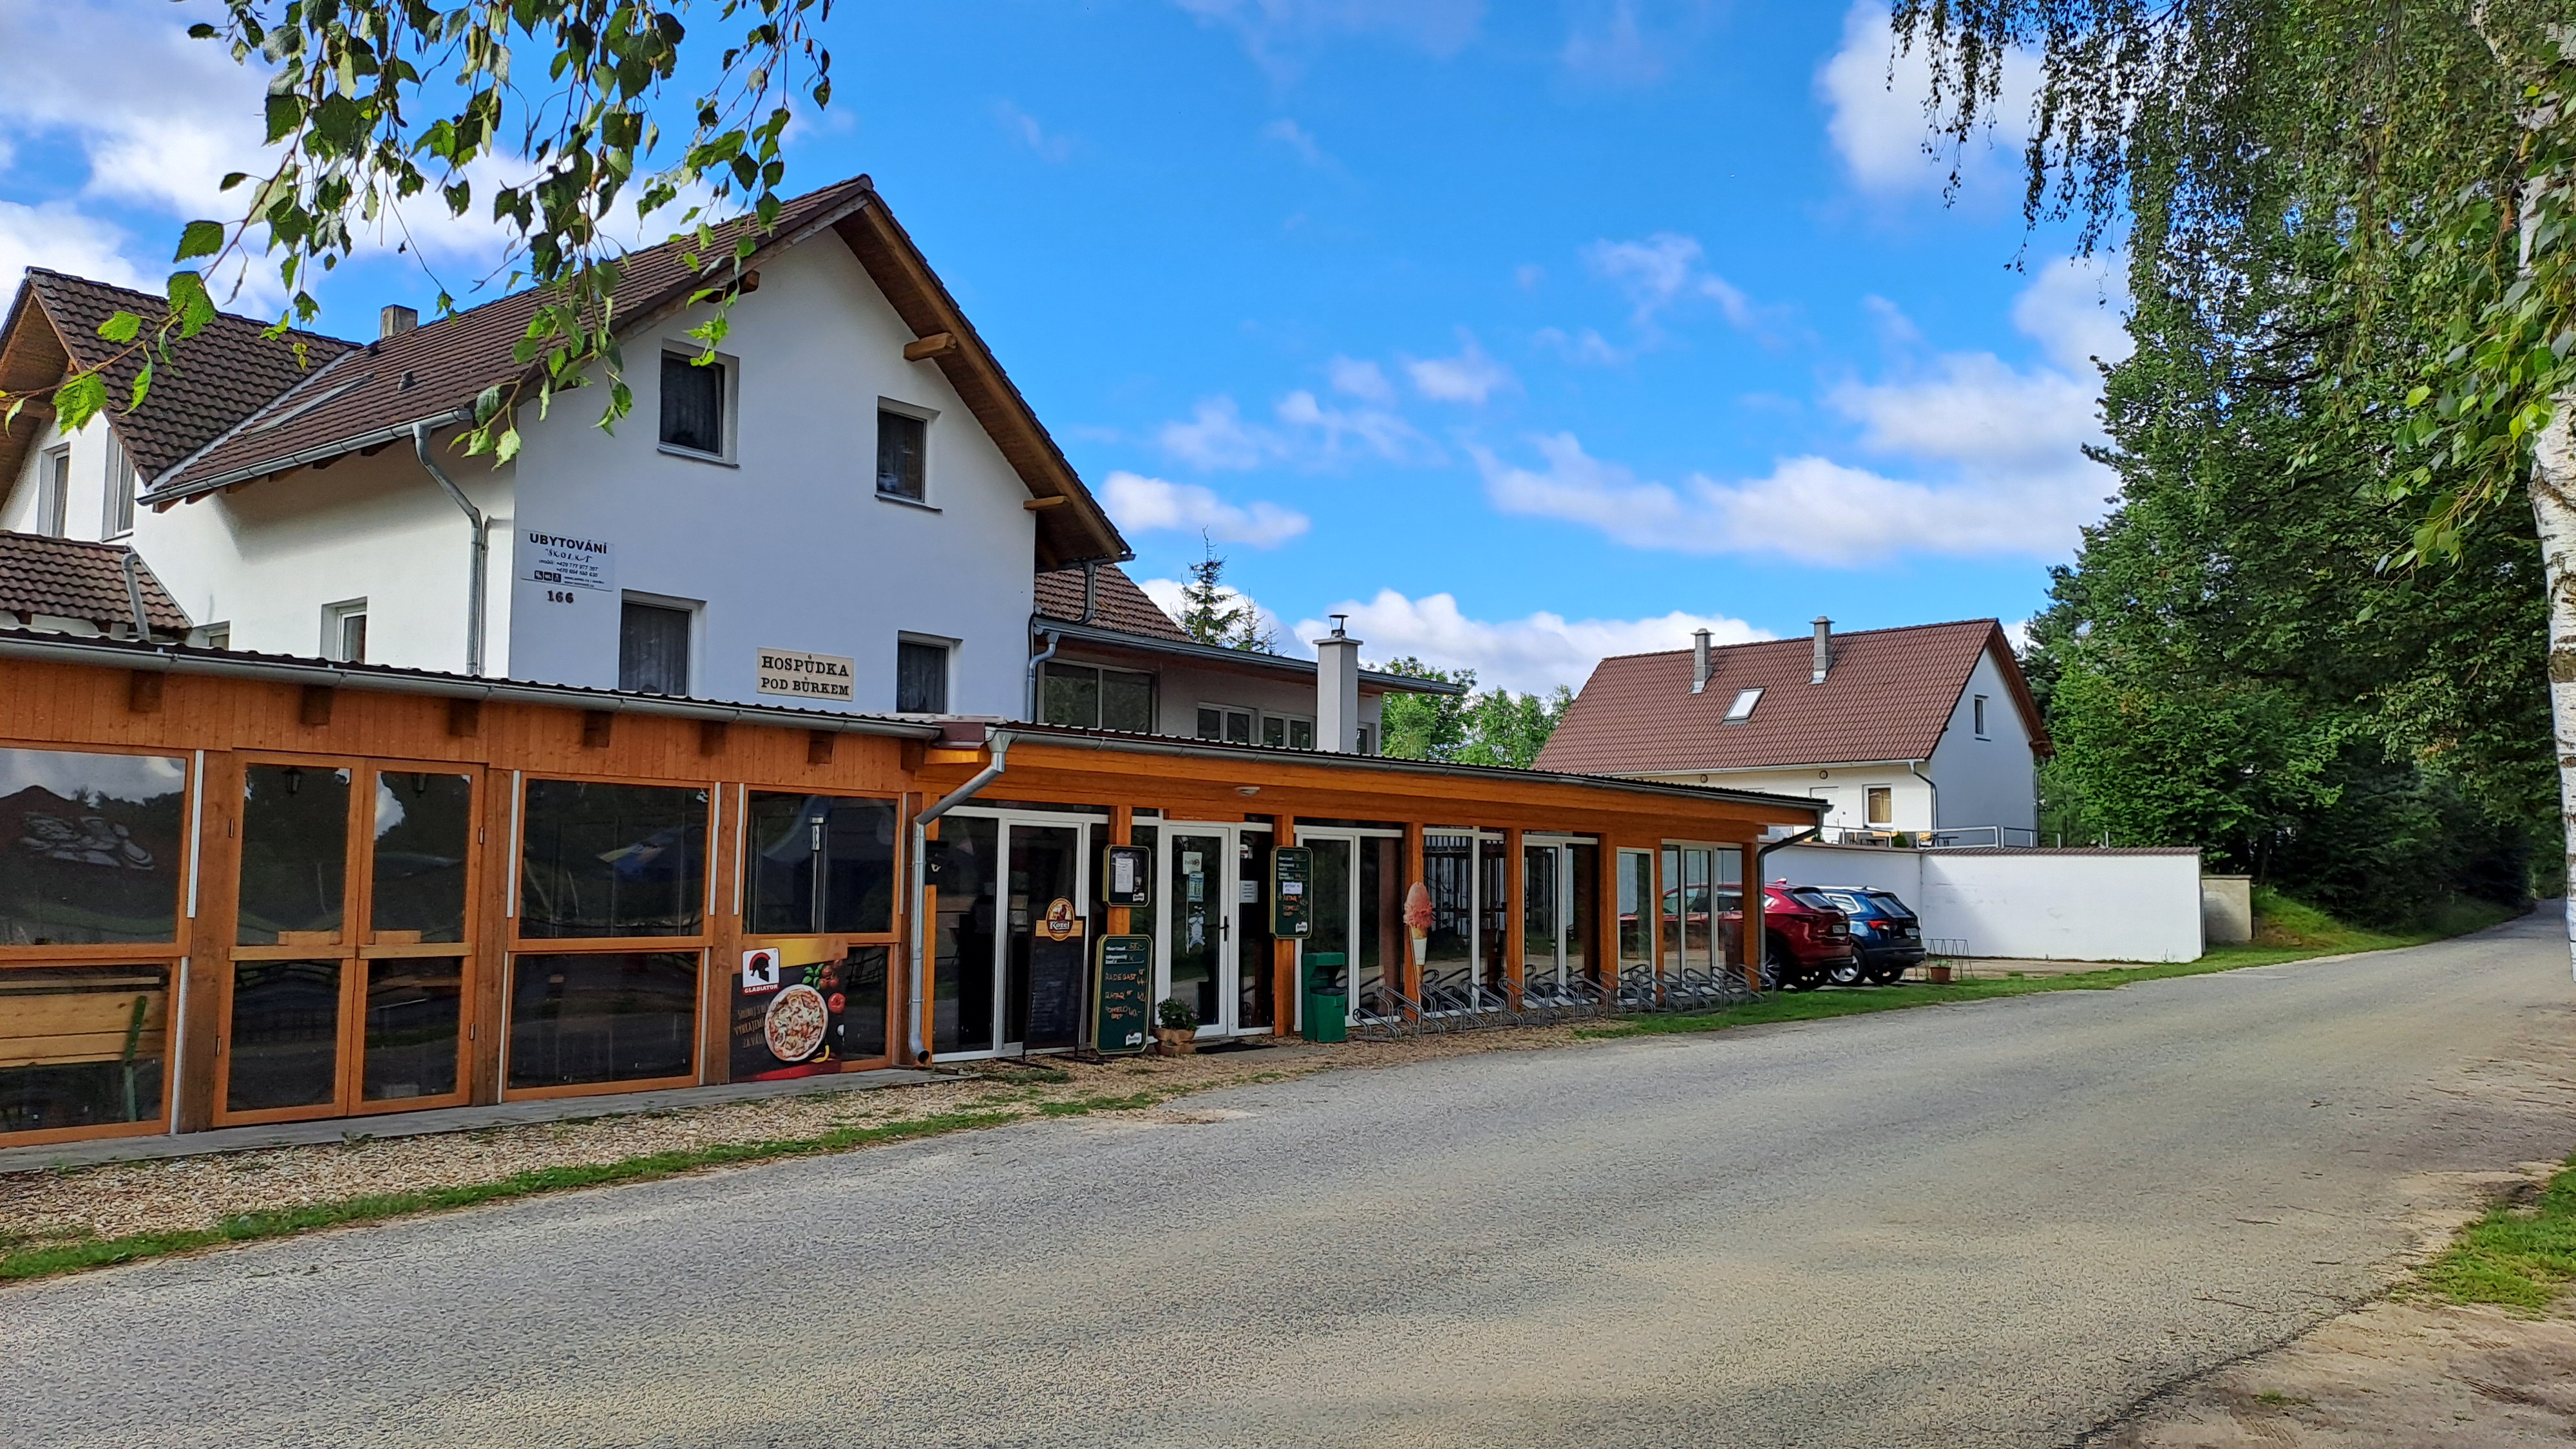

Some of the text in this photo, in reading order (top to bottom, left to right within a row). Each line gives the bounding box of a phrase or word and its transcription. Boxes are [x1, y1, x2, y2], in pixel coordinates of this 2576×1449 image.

[529, 533, 607, 554] UBYTOVÁNÍ
[547, 590, 574, 603] 166
[761, 653, 849, 677] HOSPŮDKA
[761, 677, 788, 690] POD
[1050, 921, 1070, 930] Kozel
[1105, 972, 1137, 981] RADEGAST
[744, 984, 778, 993] GLADIATOR
